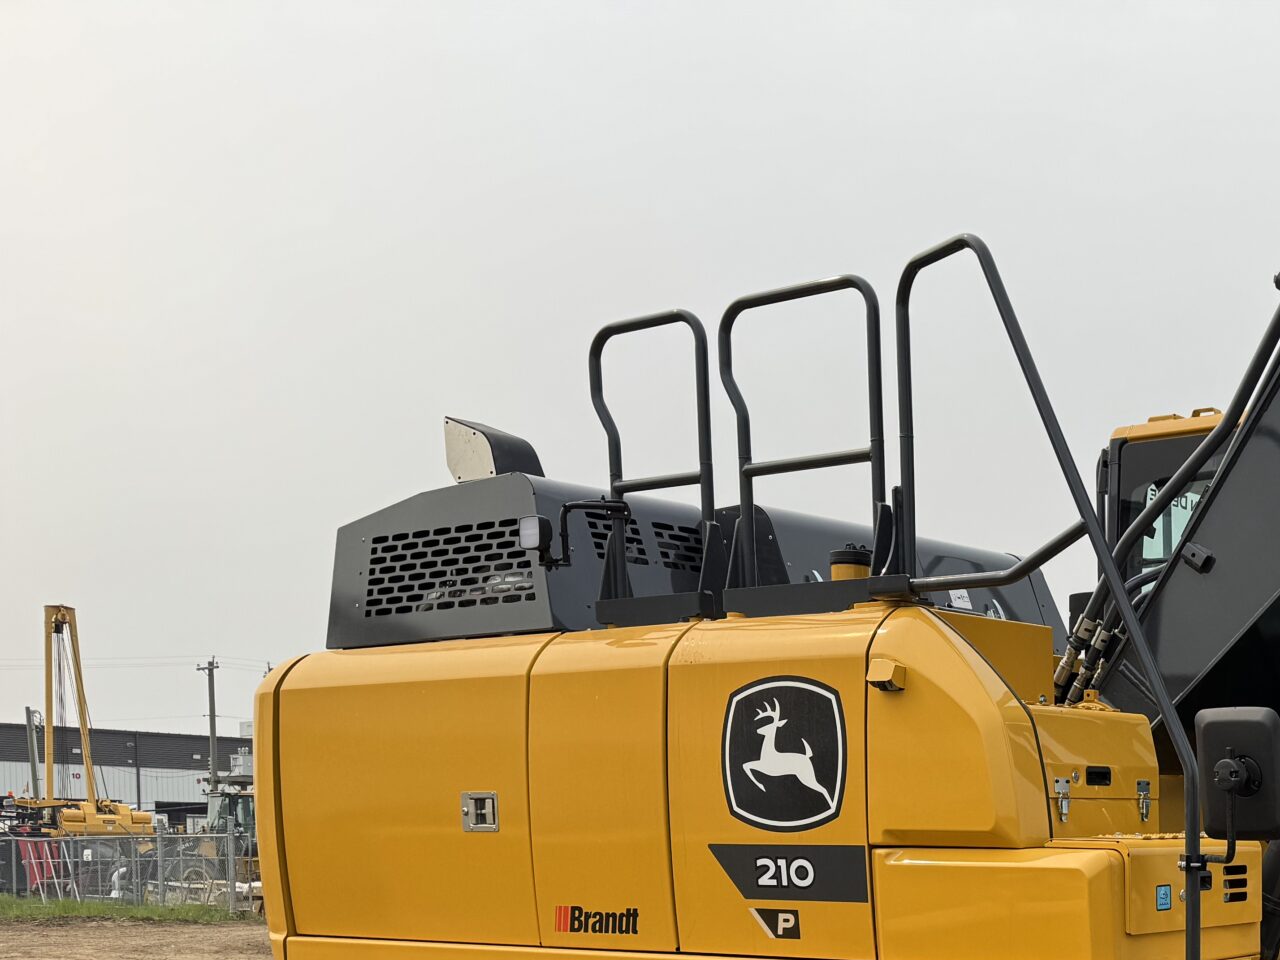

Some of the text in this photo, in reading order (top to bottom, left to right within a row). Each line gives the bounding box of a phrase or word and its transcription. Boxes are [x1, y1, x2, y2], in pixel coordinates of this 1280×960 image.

[71, 772, 81, 780] 10
[755, 857, 815, 888] 210
[569, 905, 640, 935] Brandt
[776, 912, 796, 935] P
